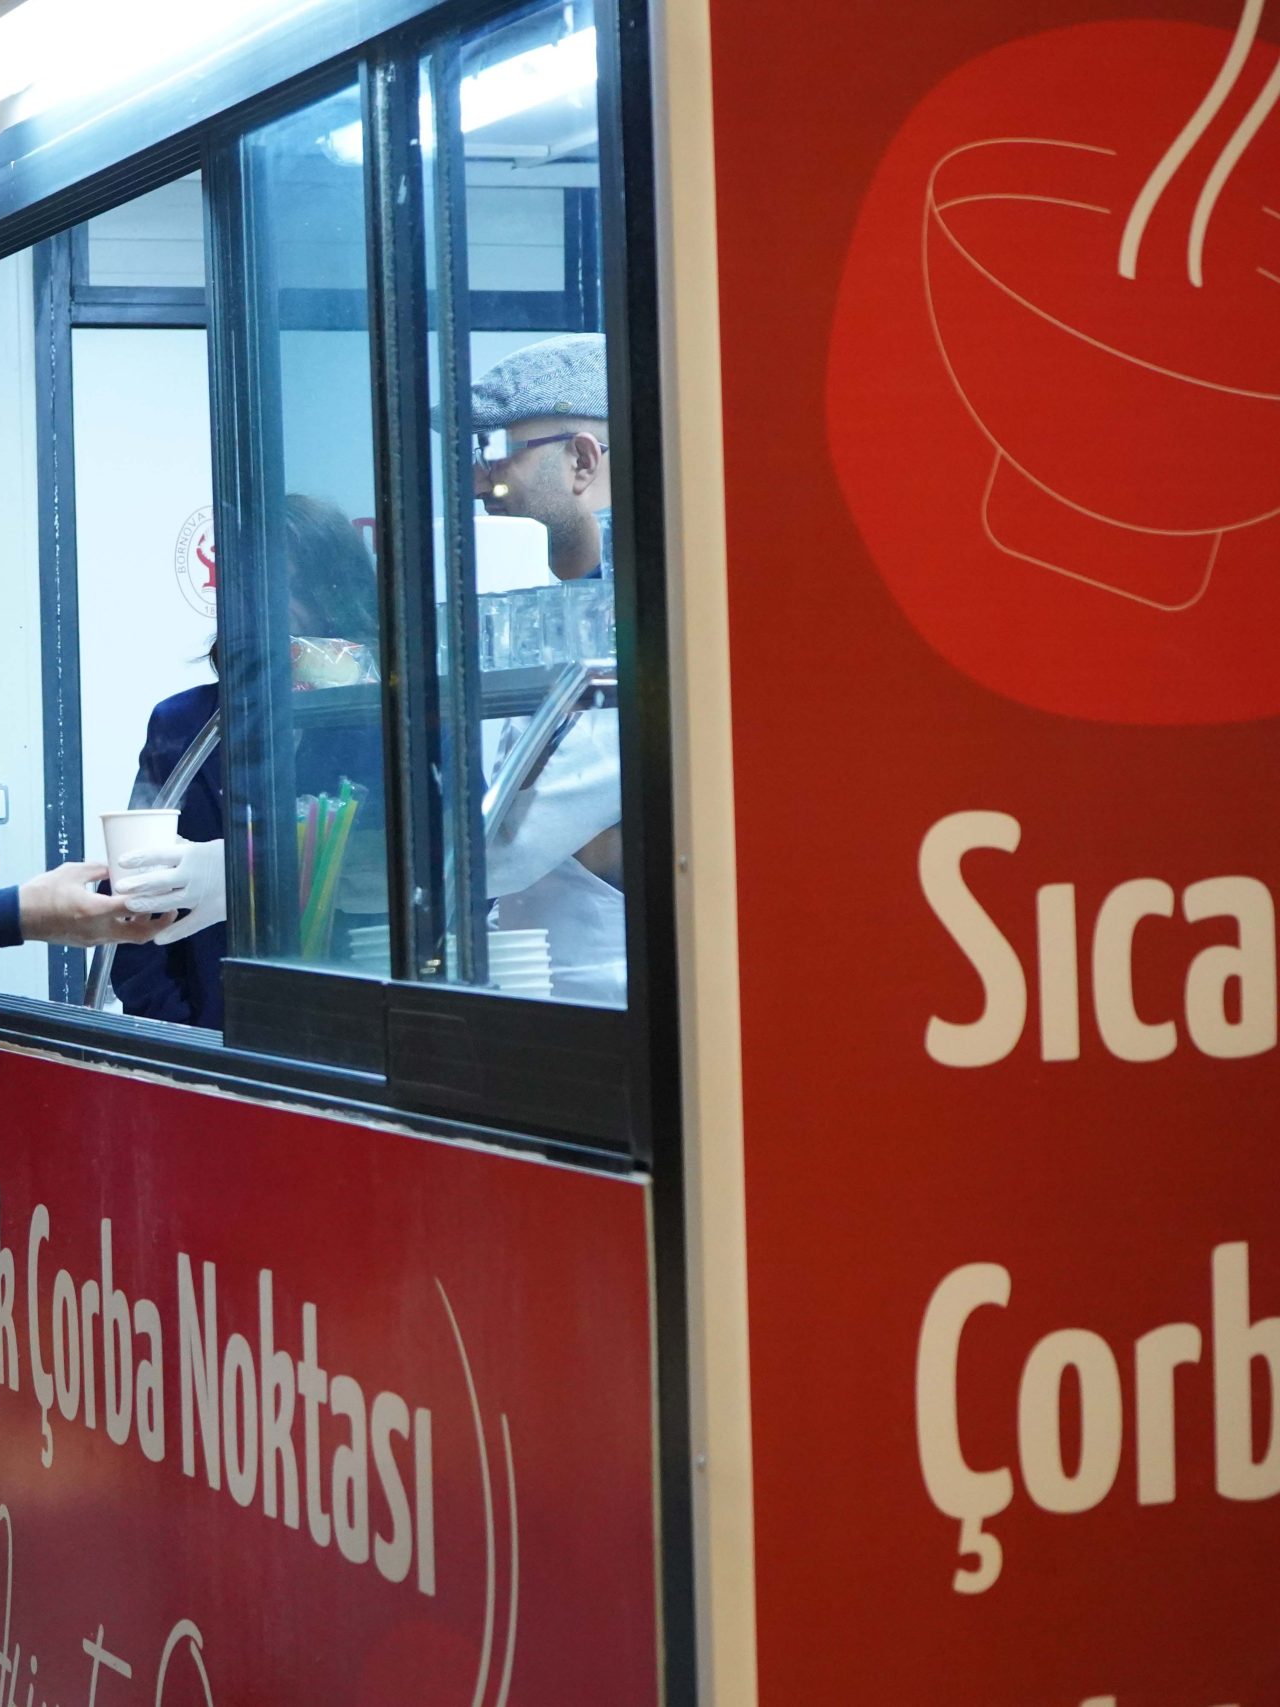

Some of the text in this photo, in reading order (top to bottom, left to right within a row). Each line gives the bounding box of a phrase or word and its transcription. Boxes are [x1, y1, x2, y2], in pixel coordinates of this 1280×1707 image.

[177, 512, 206, 574] BORNOVA
[28, 1203, 165, 1468] Çorba
[177, 1251, 436, 1597] Noktası
